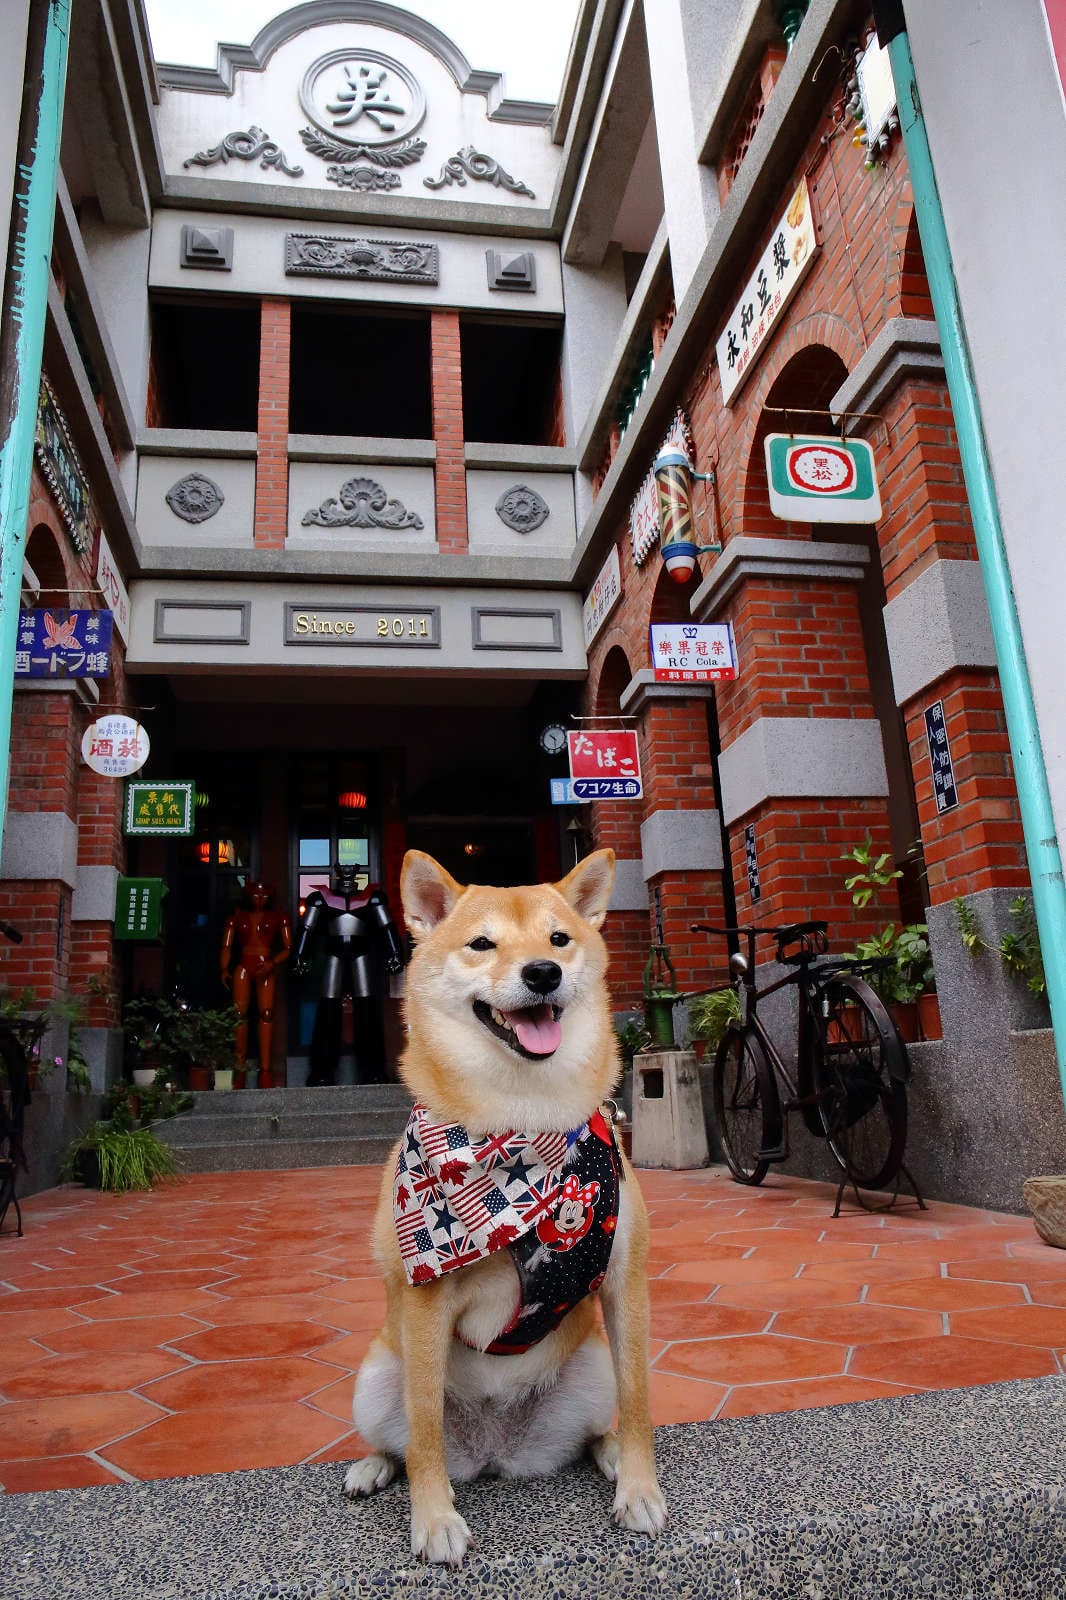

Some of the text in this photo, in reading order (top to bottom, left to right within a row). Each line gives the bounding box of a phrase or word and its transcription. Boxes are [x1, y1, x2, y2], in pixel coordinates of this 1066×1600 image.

[727, 231, 791, 371] 永和豆漿
[811, 458, 833, 481] 黑松
[85, 617, 100, 645] 美味
[294, 613, 429, 637] Since 2011
[696, 658, 719, 666] Cola
[574, 734, 636, 776] たばこ
[576, 781, 637, 794] フコク生命
